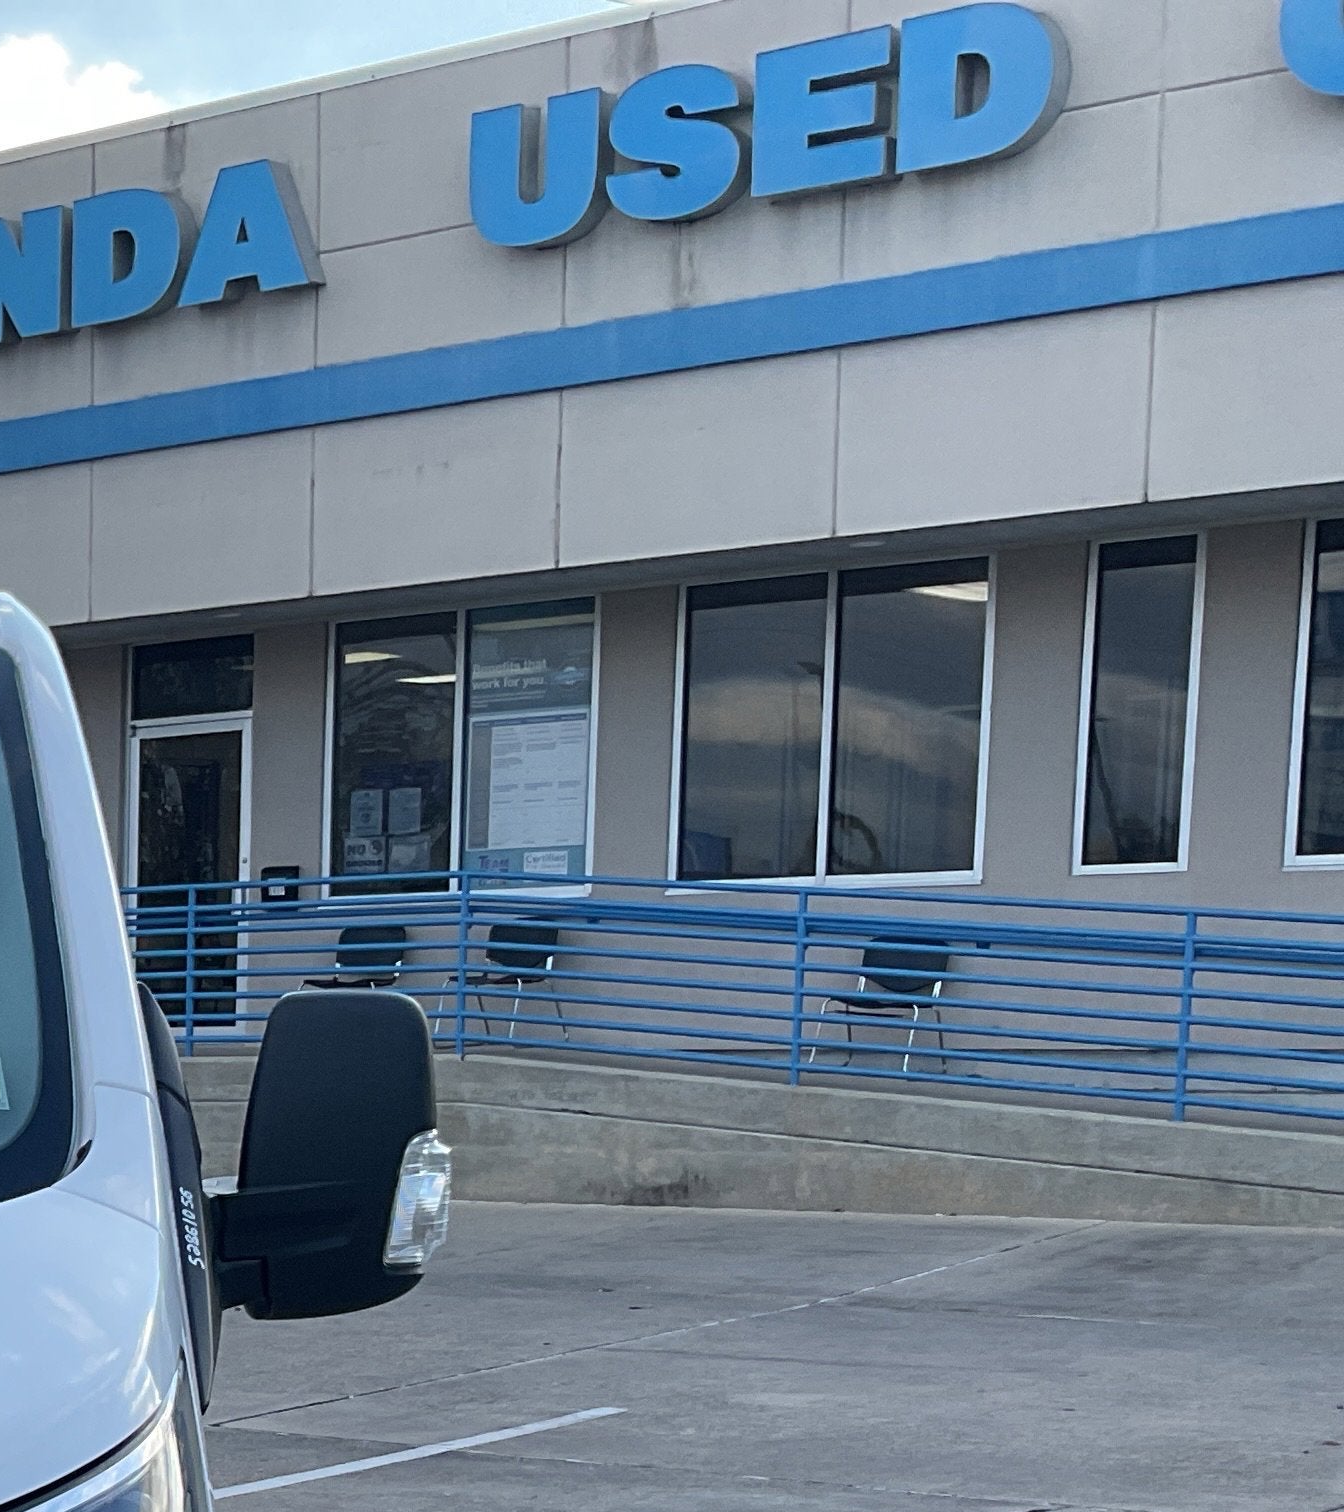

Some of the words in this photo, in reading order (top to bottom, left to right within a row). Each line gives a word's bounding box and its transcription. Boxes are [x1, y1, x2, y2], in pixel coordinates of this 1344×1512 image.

[469, 2, 1067, 249] USED
[472, 679, 500, 690] work
[503, 676, 520, 688] for
[522, 677, 544, 689] you
